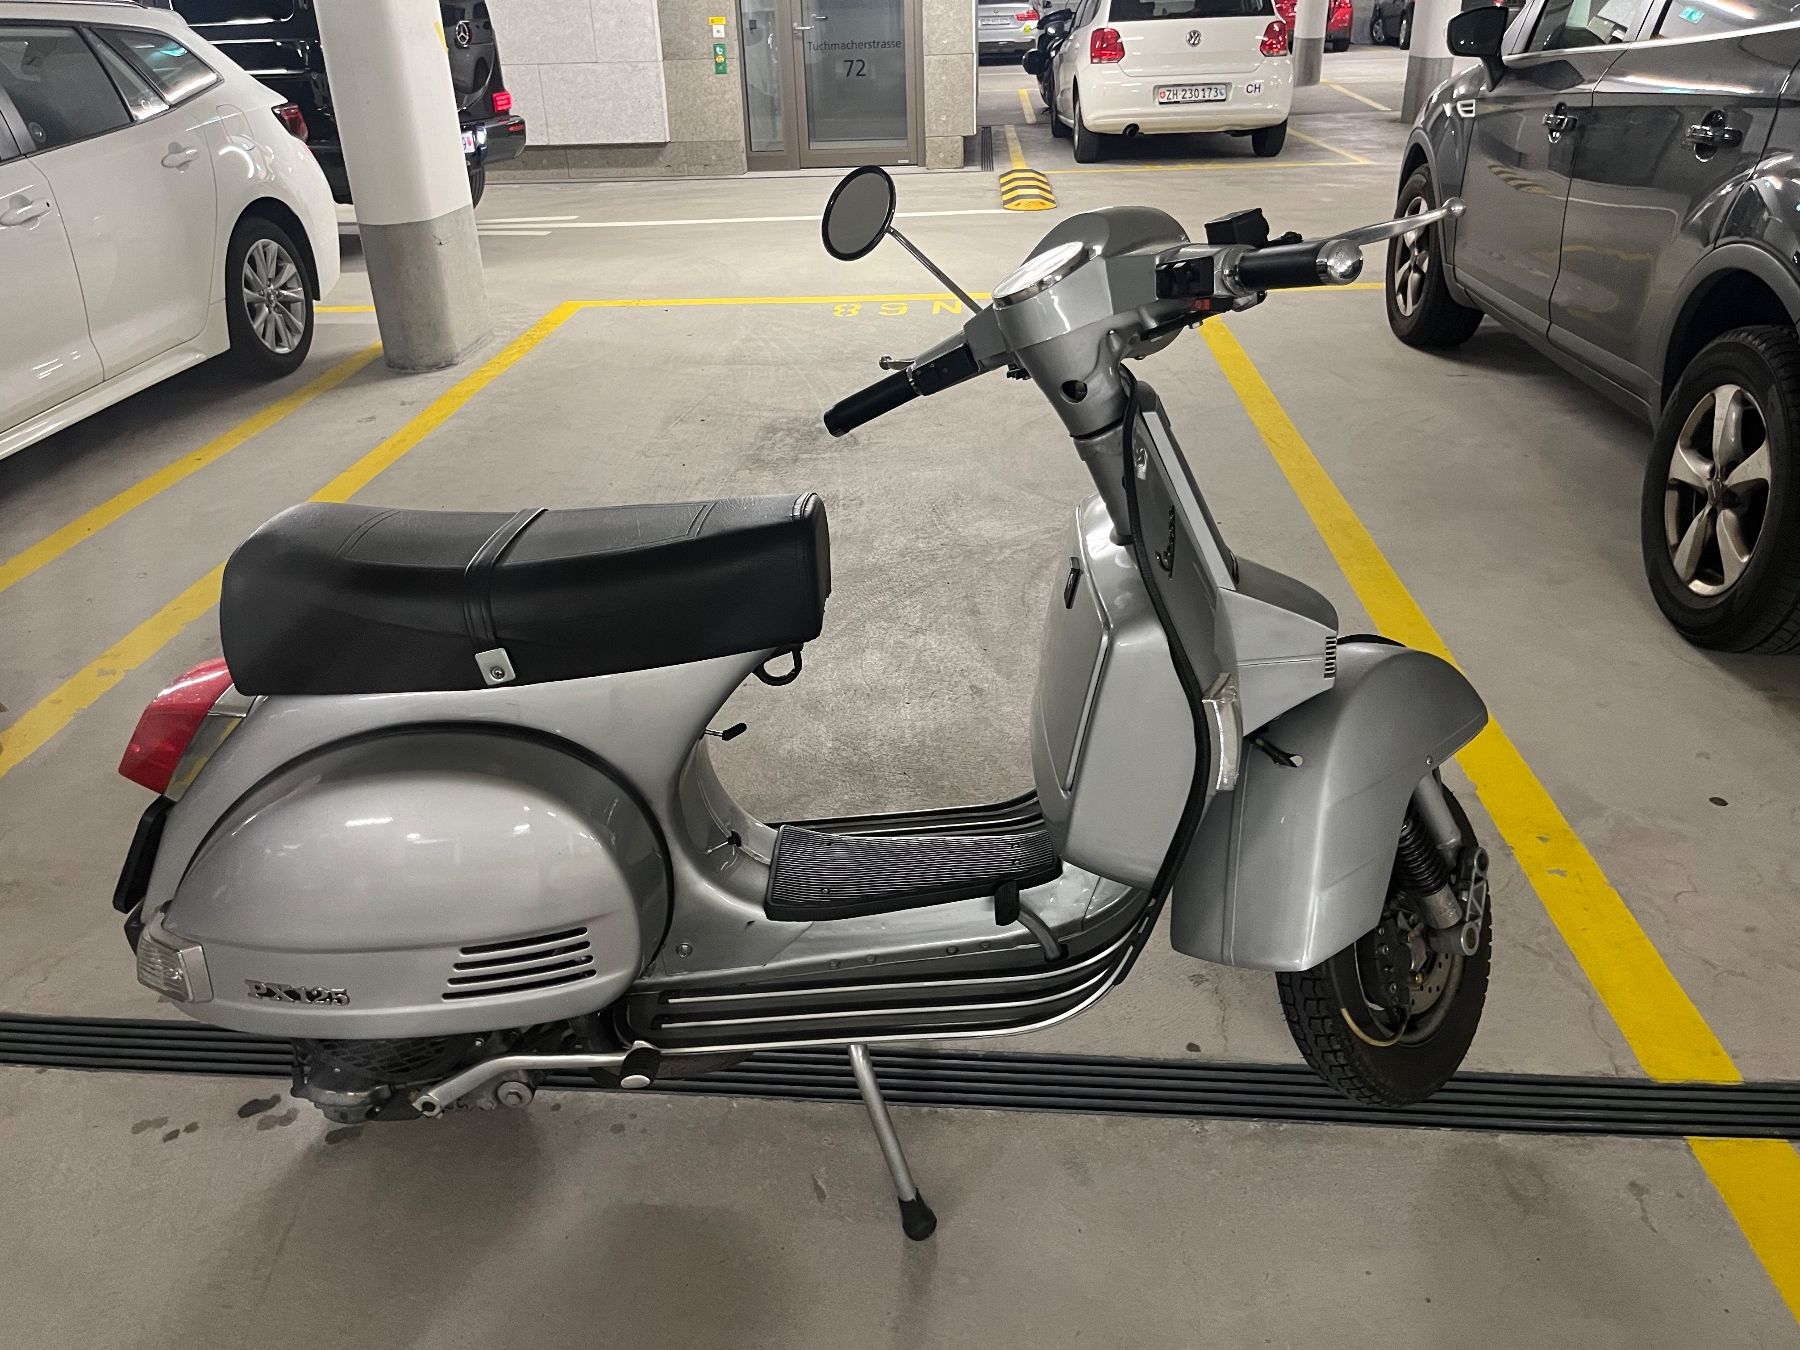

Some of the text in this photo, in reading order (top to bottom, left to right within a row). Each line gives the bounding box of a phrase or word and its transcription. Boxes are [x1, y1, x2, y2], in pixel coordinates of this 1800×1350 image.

[807, 40, 902, 51] Tuchmacherstrasse
[843, 59, 867, 78] 72
[1246, 84, 1261, 94] CH
